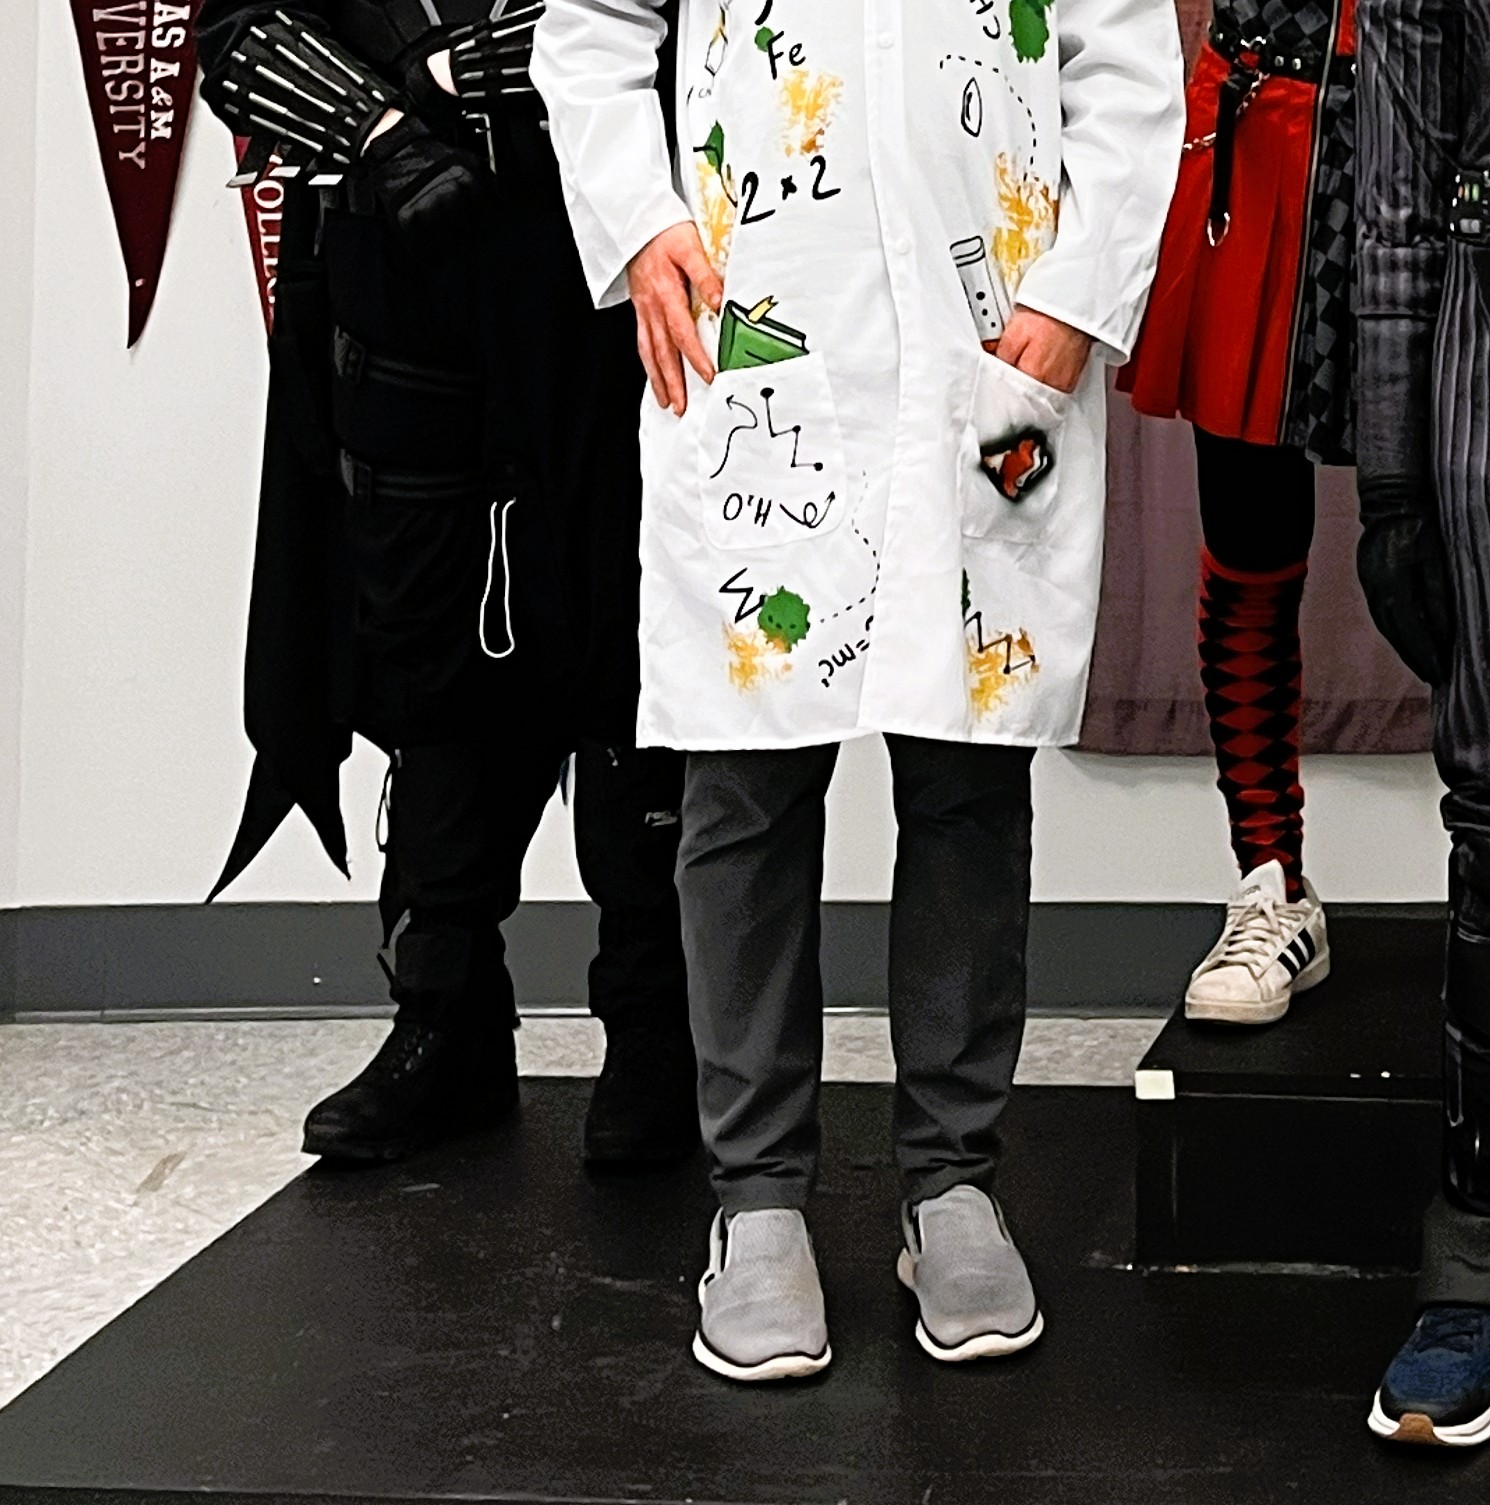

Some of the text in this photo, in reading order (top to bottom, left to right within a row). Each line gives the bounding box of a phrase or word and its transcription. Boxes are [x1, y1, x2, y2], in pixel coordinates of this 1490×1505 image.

[768, 31, 806, 80] Fe
[150, 58, 181, 141] A&M
[740, 171, 777, 225] 2
[810, 155, 842, 200] 2
